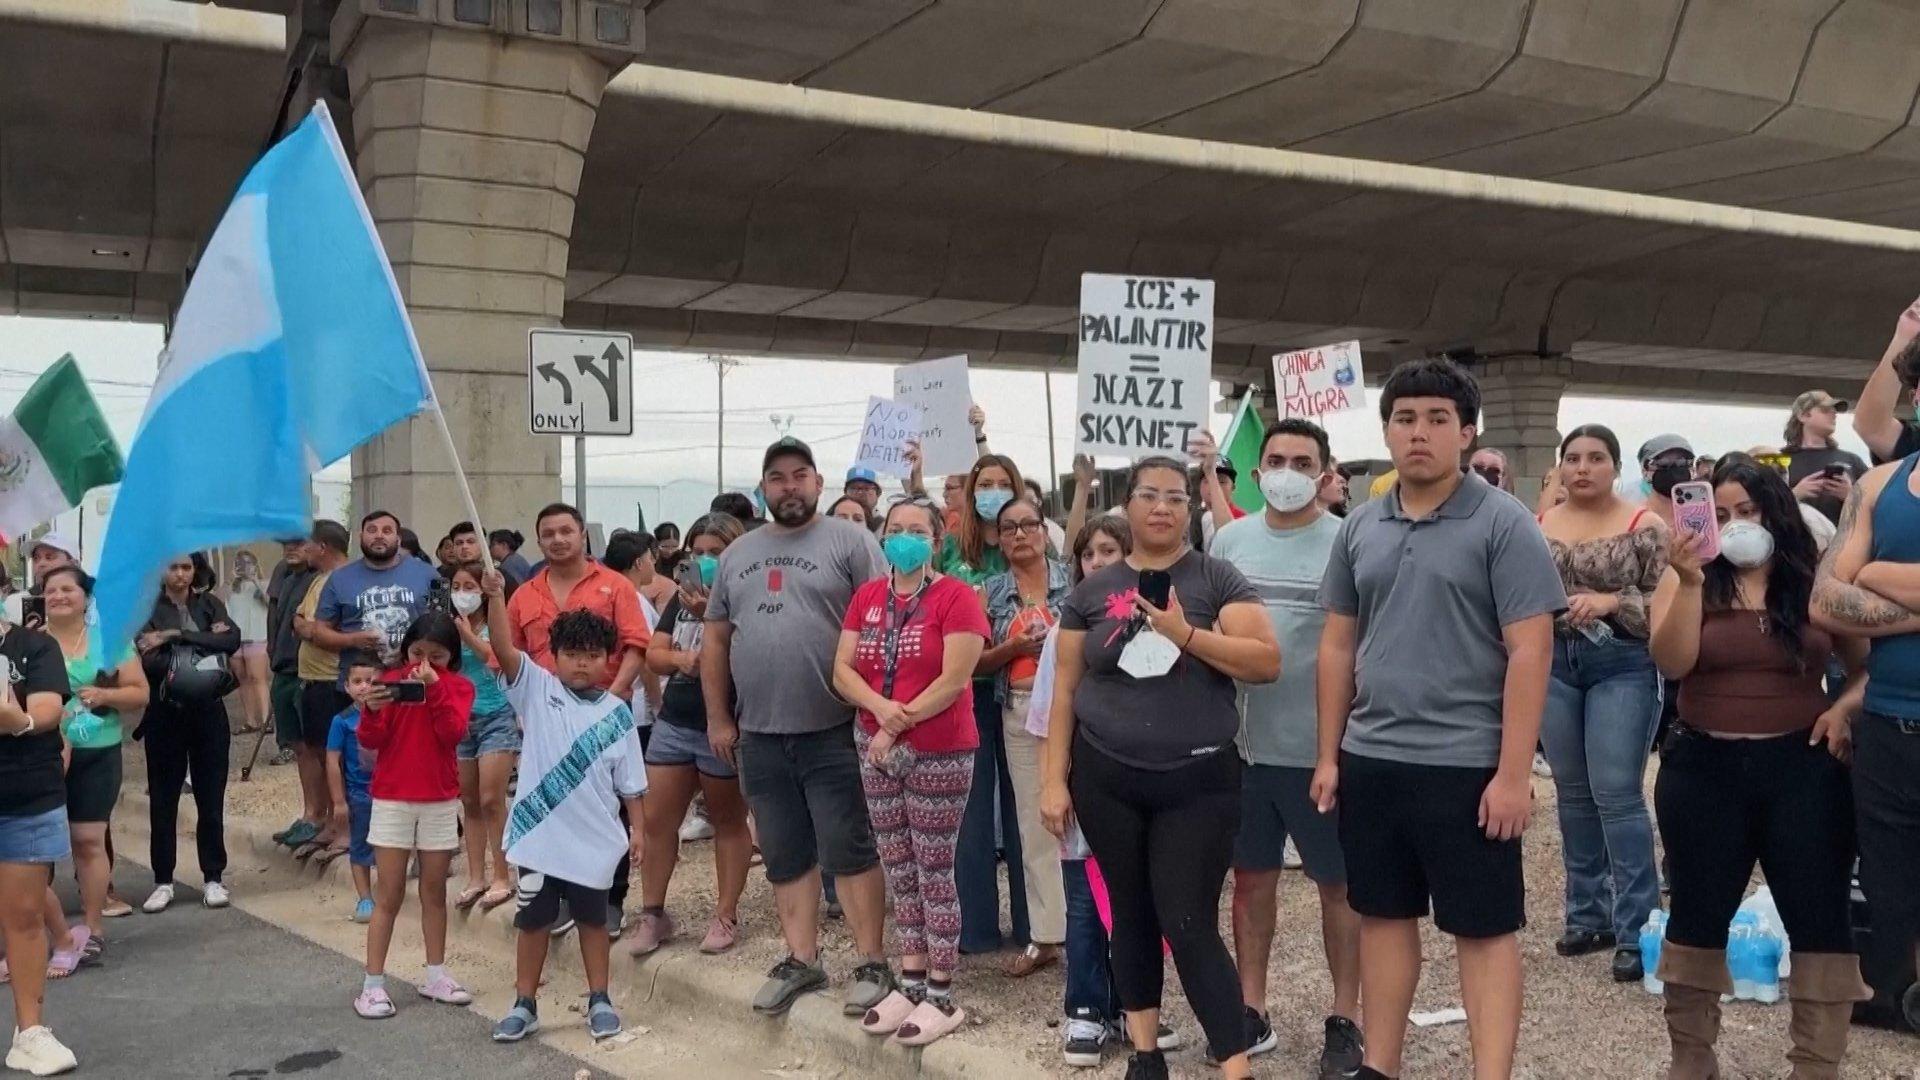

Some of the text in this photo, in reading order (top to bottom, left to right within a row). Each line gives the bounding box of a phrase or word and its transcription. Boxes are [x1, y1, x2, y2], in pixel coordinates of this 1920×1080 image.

[1124, 279, 1201, 310] ICE +
[1081, 314, 1208, 351] PALINTIR
[1278, 350, 1326, 377] CHINGA
[1092, 373, 1184, 410] NAZI
[1283, 376, 1312, 399] LA
[868, 402, 909, 422] NO
[1285, 388, 1350, 419] MIGRA
[534, 413, 580, 429] ONLY
[1079, 413, 1198, 452] SKYNET
[739, 555, 818, 579] THE COOLEST
[757, 602, 784, 614] POP
